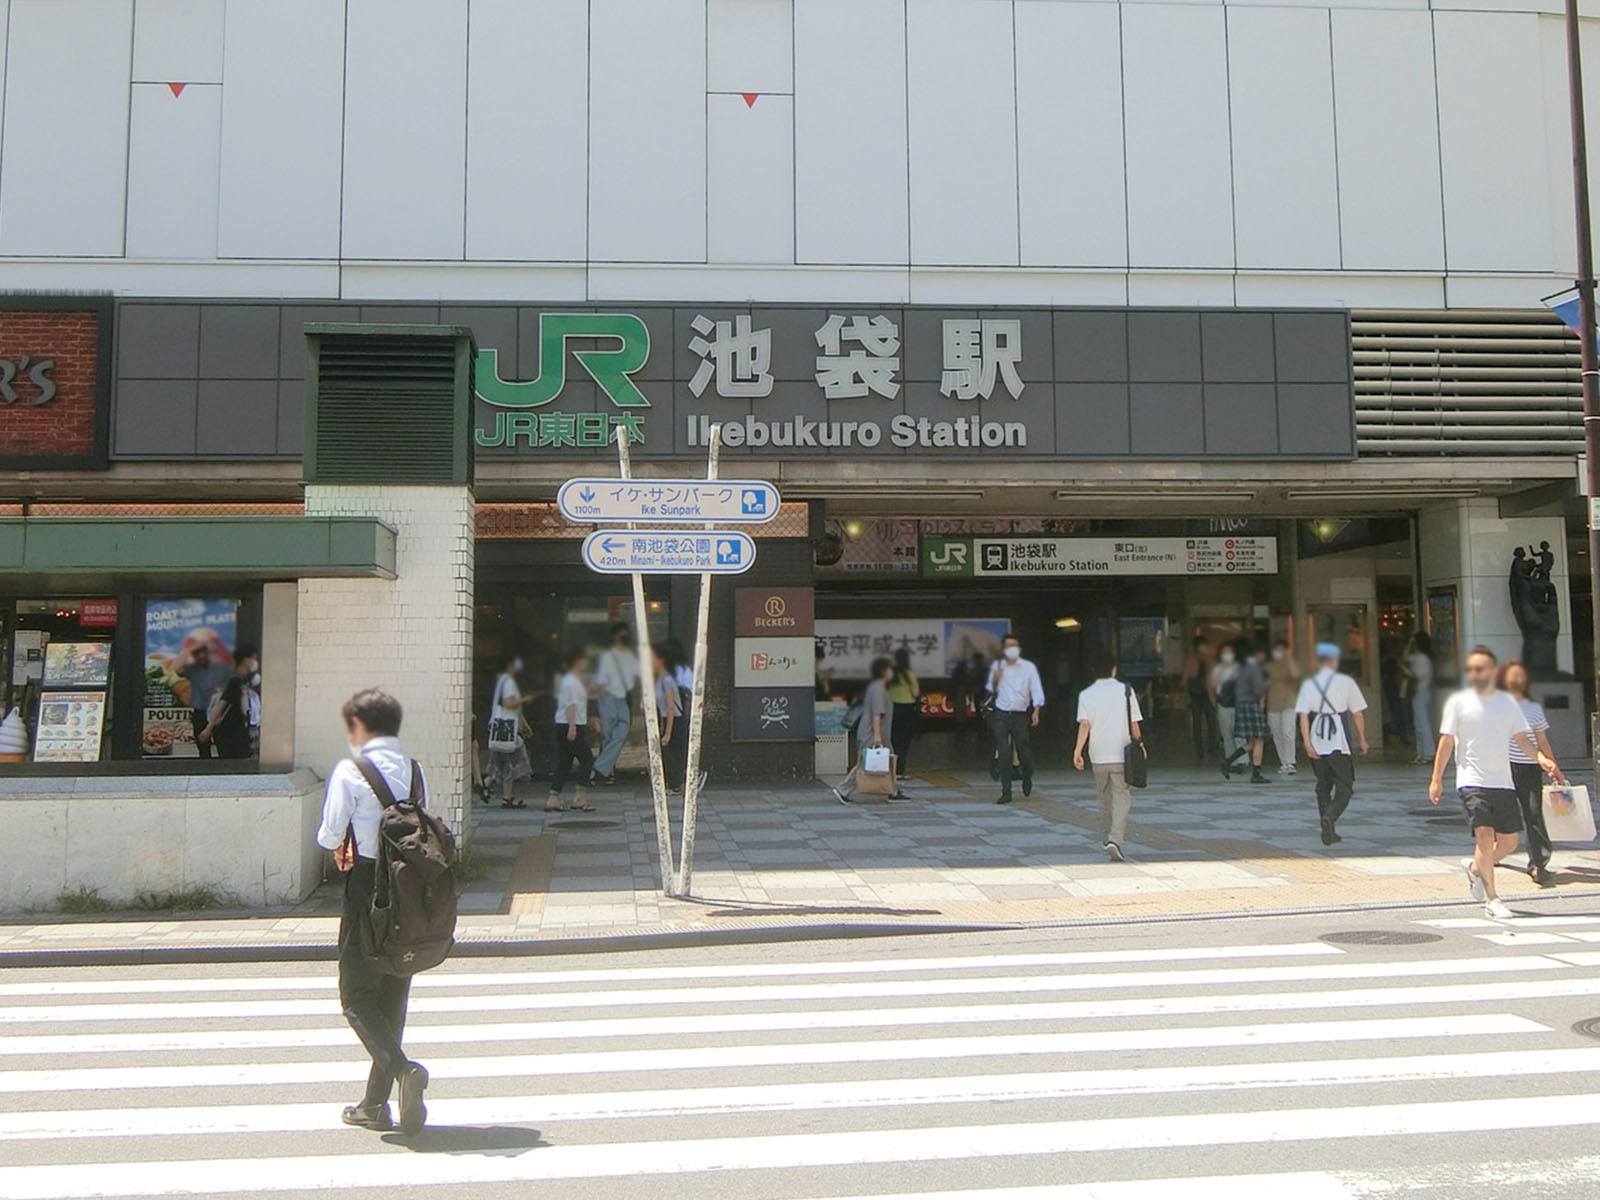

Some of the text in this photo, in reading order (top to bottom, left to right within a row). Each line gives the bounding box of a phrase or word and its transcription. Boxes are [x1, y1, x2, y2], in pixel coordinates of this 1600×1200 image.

[475, 313, 651, 408] JR
[687, 314, 1025, 400] 池袋駅
[475, 412, 646, 447] JR東日本
[890, 414, 1027, 447] Station
[574, 505, 600, 515] 1100m
[641, 503, 701, 516] Ike Sunpark
[631, 538, 711, 554] 南池袋公園
[1010, 543, 1058, 559] 池袋駅
[695, 555, 711, 565] Park
[930, 543, 968, 564] JR
[1114, 554, 1130, 563] East
[600, 556, 627, 566] 420m
[1010, 560, 1109, 572] Ikebukuro Station
[754, 616, 796, 628] BECKER'S
